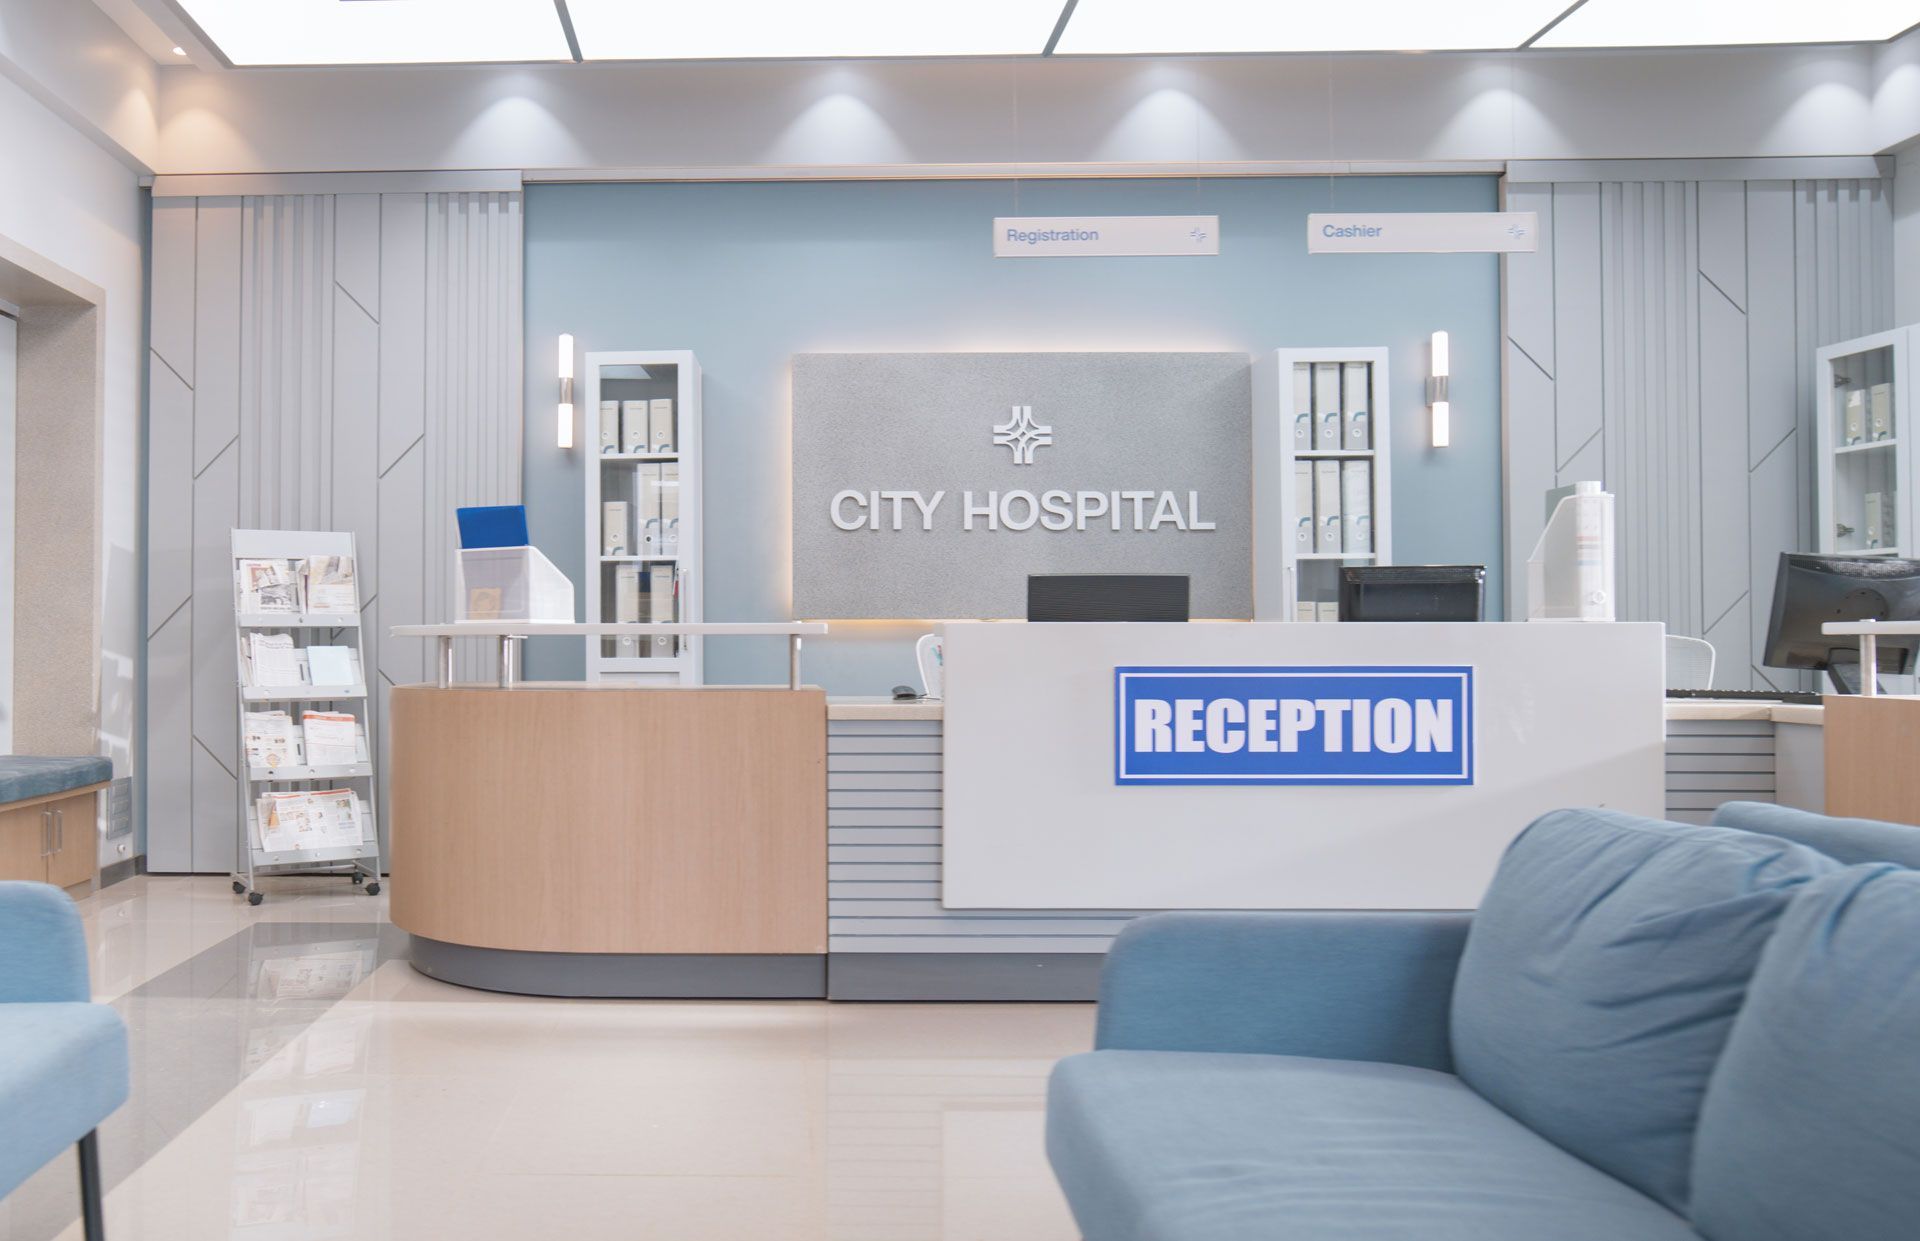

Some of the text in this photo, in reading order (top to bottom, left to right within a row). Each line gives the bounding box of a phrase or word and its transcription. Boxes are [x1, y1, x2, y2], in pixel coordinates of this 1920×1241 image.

[1007, 229, 1098, 244] Registration
[1322, 223, 1382, 238] Cashier
[829, 489, 1217, 532] CITY HOSPITAL
[1133, 697, 1453, 755] RECEPTION
